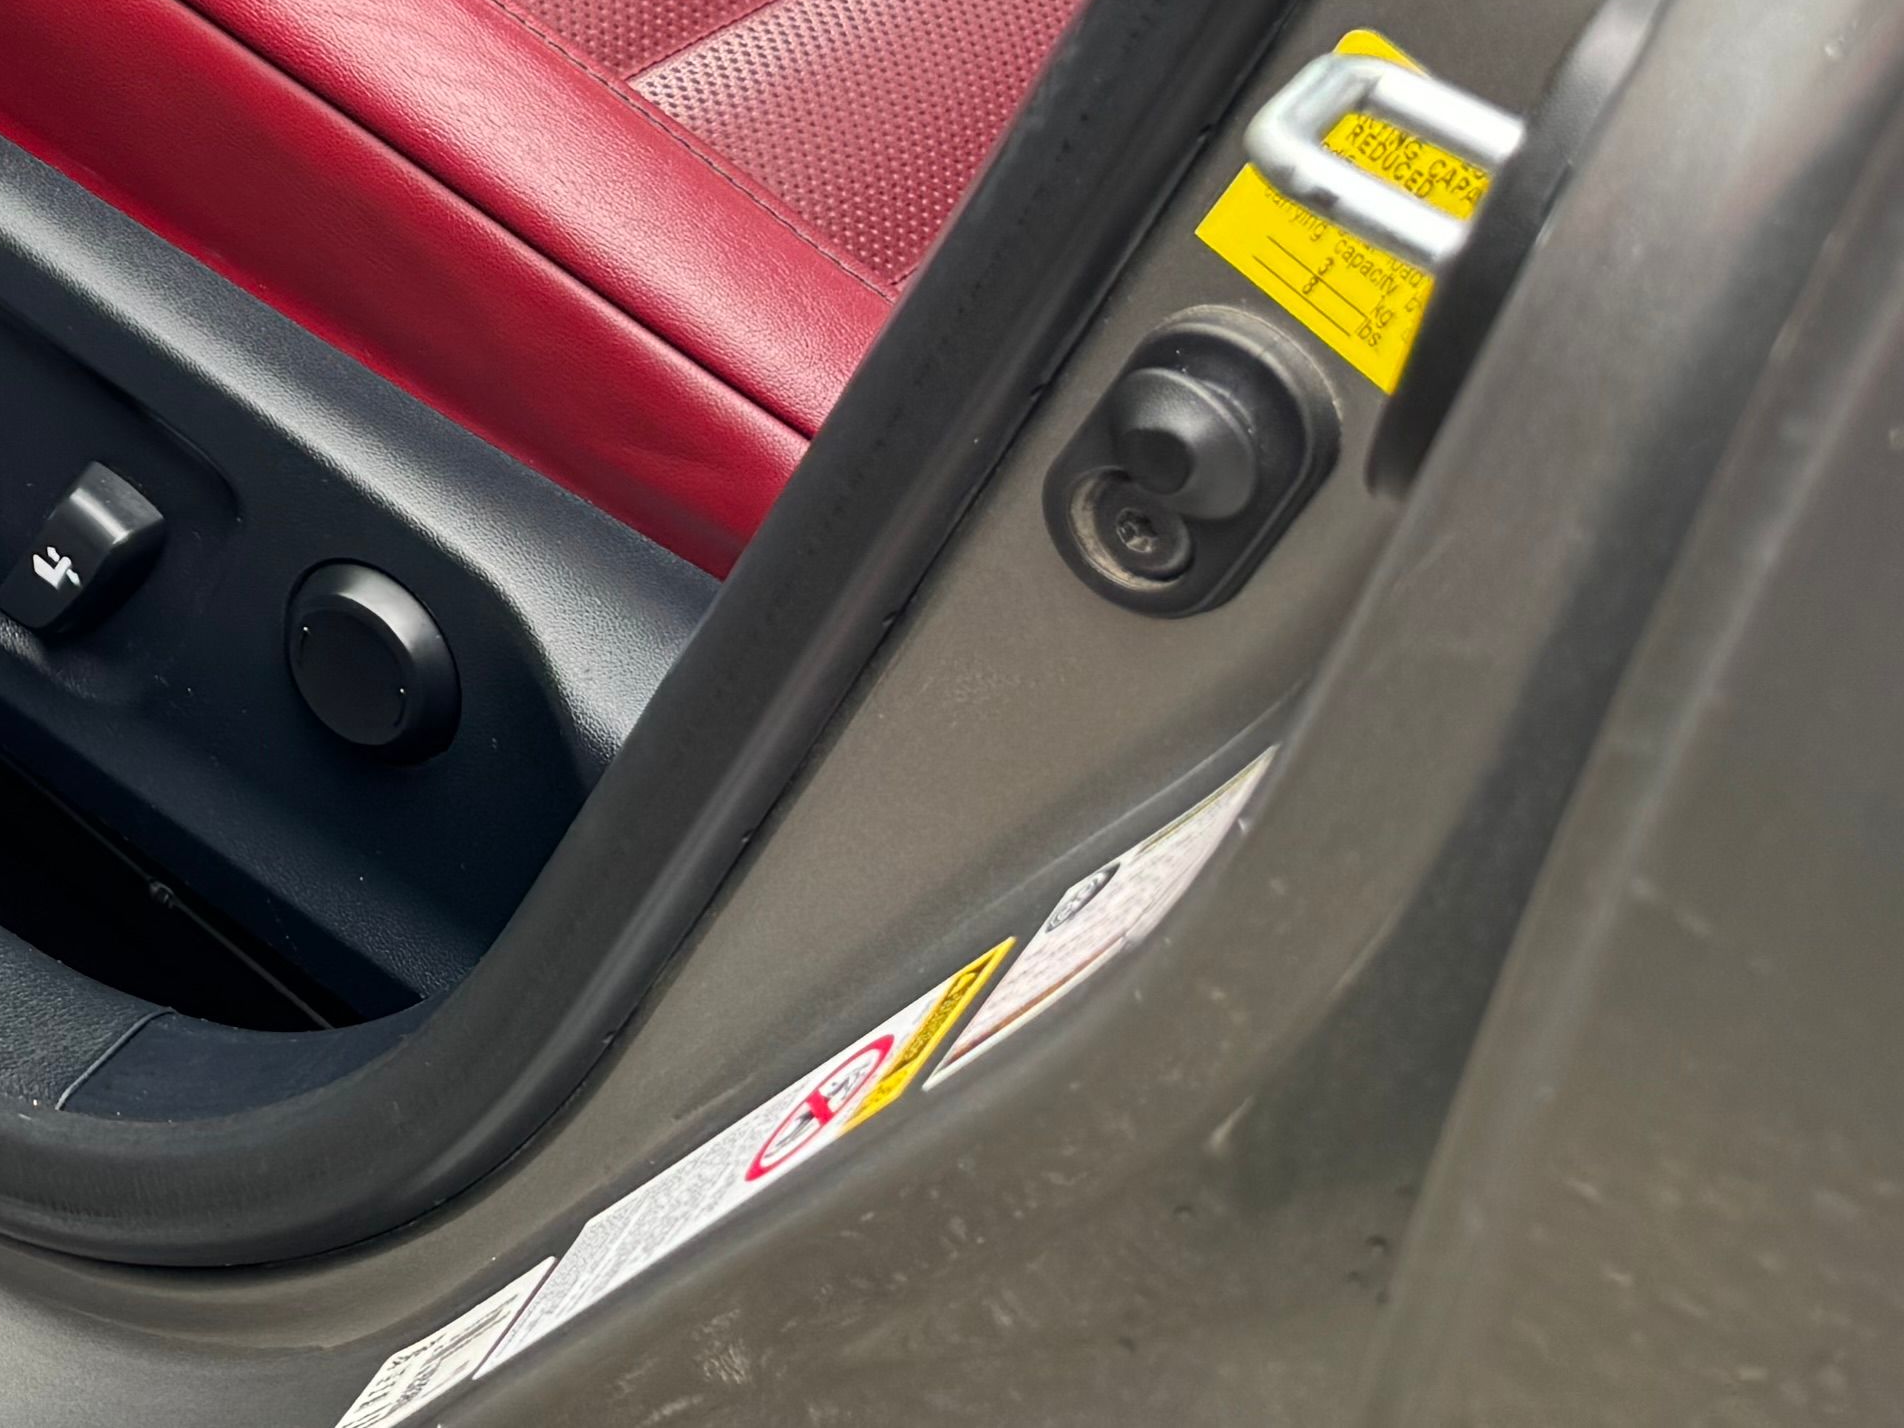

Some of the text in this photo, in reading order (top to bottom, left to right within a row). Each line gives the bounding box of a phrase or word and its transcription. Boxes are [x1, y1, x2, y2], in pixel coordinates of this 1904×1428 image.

[1346, 124, 1435, 199] REDUCED
[1302, 275, 1321, 295] 8
[1318, 257, 1395, 329] 3 kg
[1334, 239, 1400, 296] capacity
